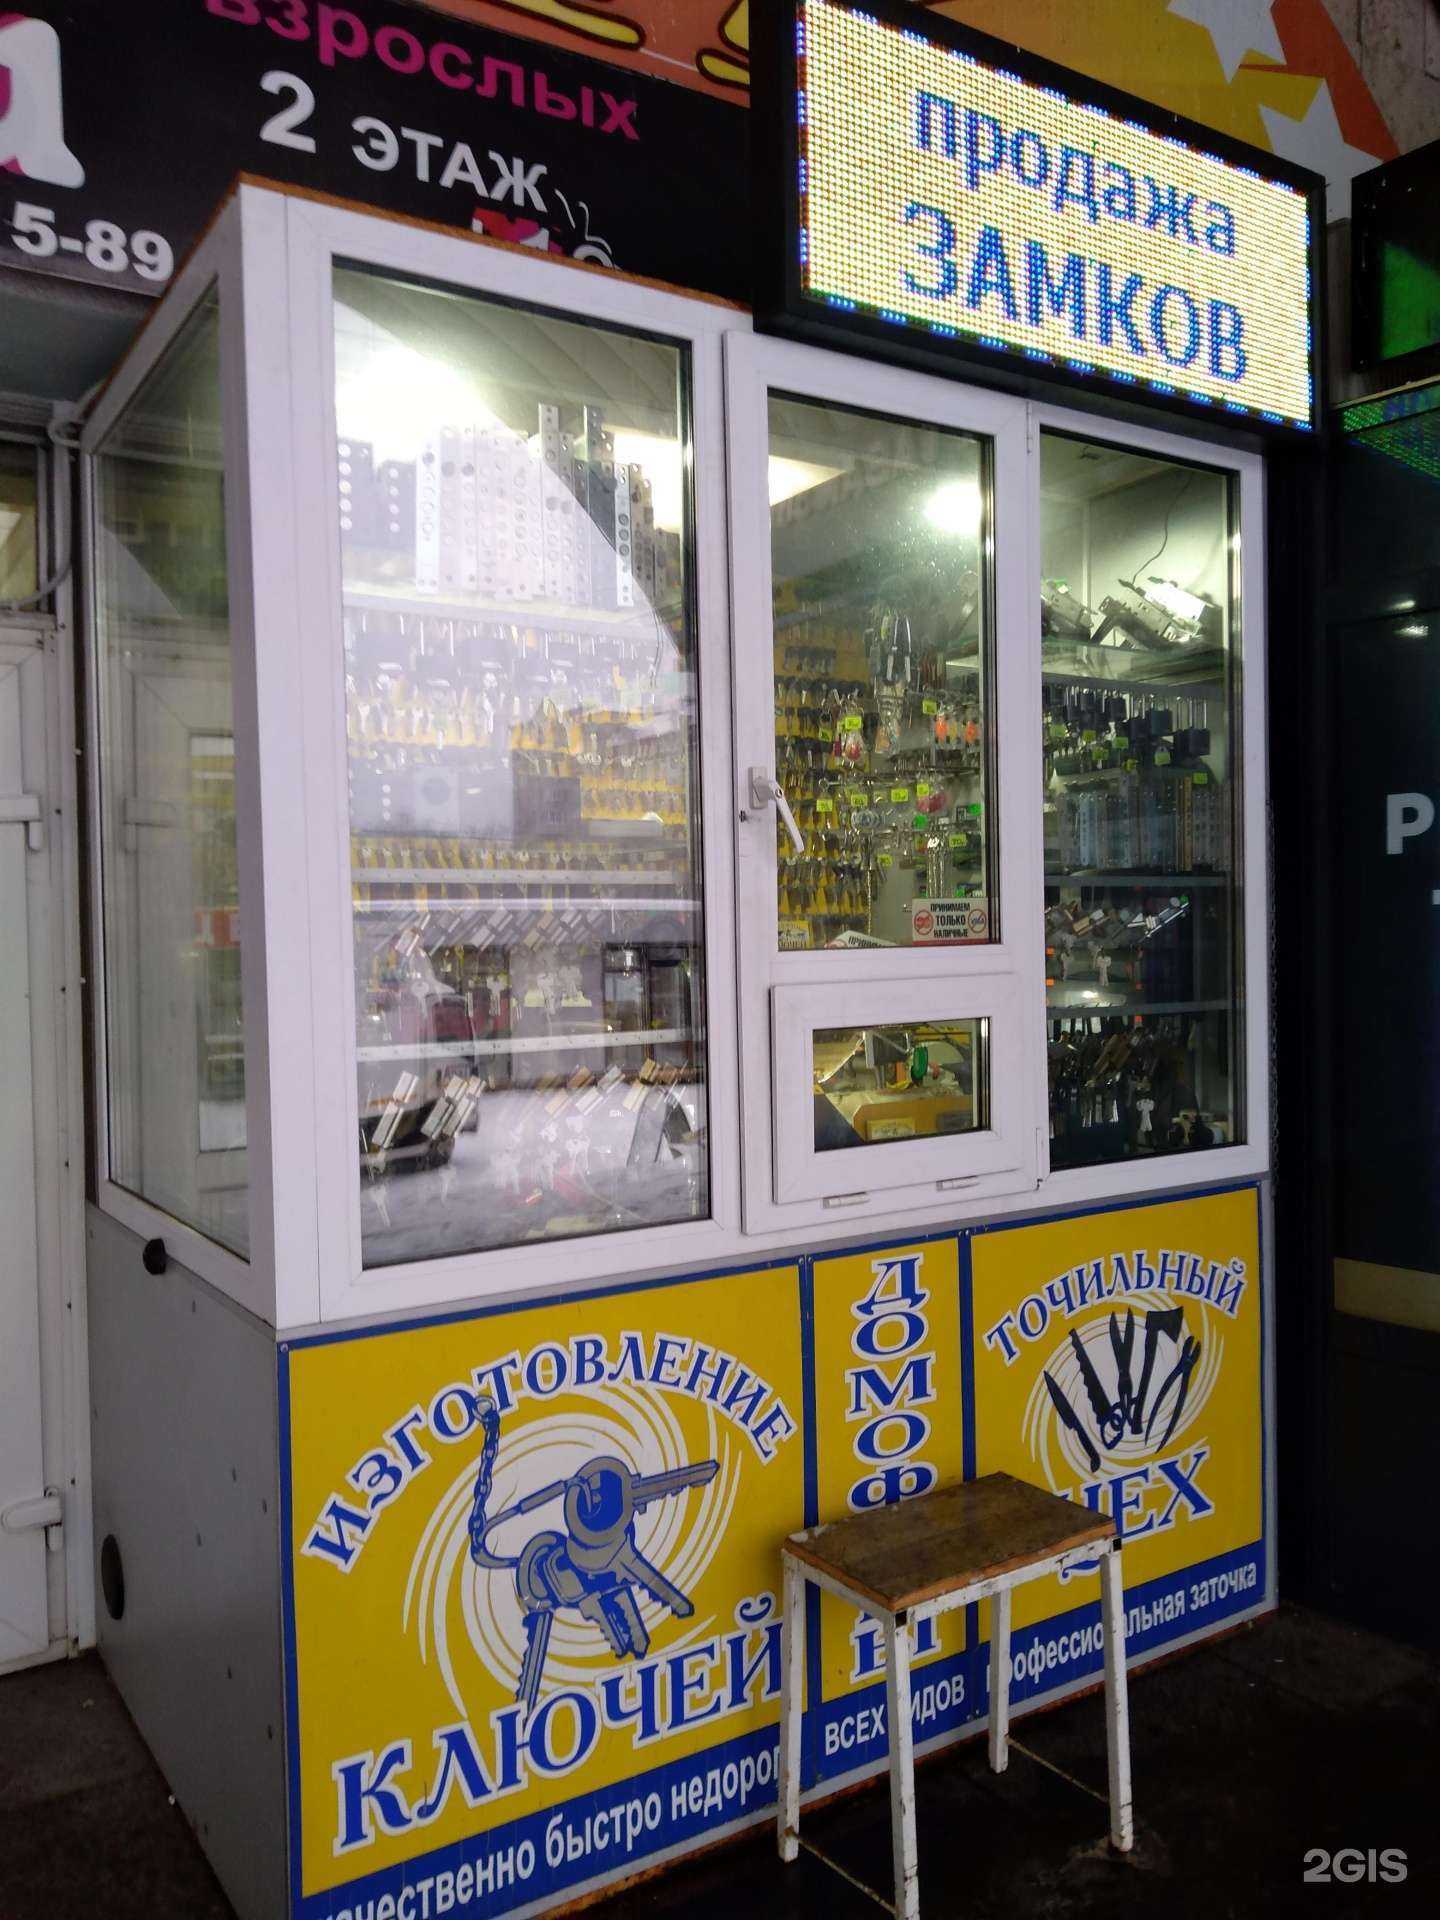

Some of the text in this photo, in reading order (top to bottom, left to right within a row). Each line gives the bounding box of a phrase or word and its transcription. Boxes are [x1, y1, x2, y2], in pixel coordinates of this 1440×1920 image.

[260, 70, 548, 212] 2 ЭТАЖ
[913, 90, 1236, 257] продажа
[11, 200, 175, 282] 5-89
[903, 201, 1247, 384] ЗАМКОВ
[935, 915, 966, 926] ТОЛЬКО
[986, 1252, 1247, 1363] ТОЧИЛЬНЫЙ
[305, 1333, 796, 1570] ИЗГОТОВЛЕНИЕ
[1190, 1562, 1258, 1612] заточка
[335, 1596, 784, 1852] КЛЮЧЕЙ
[825, 1673, 966, 1757] ВСЕХ ИДОВ
[545, 1792, 662, 1868] быстро
